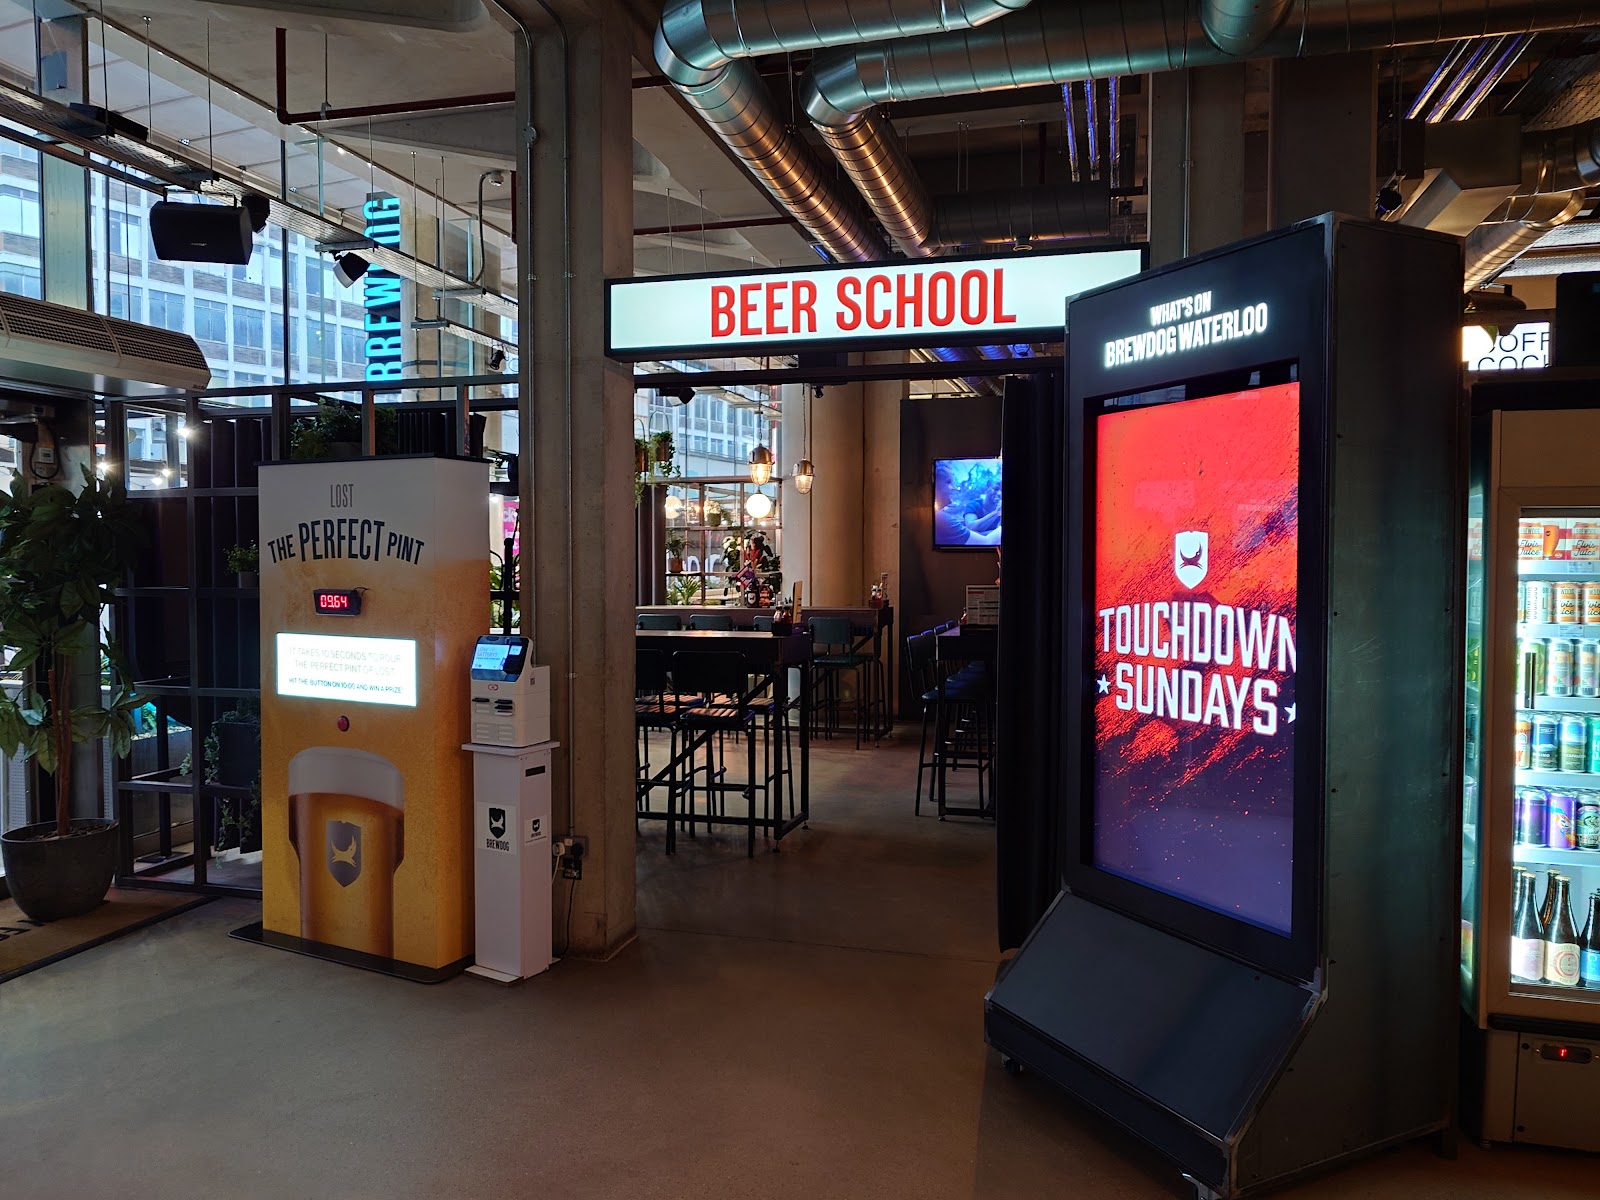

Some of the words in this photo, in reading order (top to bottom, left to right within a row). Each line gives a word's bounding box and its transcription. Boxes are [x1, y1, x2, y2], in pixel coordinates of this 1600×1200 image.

[363, 197, 402, 382] BREWOG
[710, 279, 817, 337] BEER
[836, 268, 1016, 333] SCHOOL
[1150, 296, 1194, 327] WHAT'S
[1194, 290, 1212, 315] ON
[1104, 326, 1177, 368] BREWDOG
[1178, 302, 1268, 351] WATERLOO
[330, 483, 354, 508] LOST
[267, 533, 296, 564] THE
[298, 518, 385, 562] PERFECT
[386, 531, 425, 565] PINT
[297, 648, 320, 657] TAKES
[330, 650, 367, 661] SECONDS
[1099, 601, 1296, 673] TOUCHDOWN
[295, 659, 308, 669] THE
[310, 661, 343, 672] PERFECT
[344, 663, 361, 673] PINT
[310, 679, 332, 687] BUTTON
[1115, 662, 1278, 736] SUNDAYS
[486, 838, 510, 852] BREWDOG
